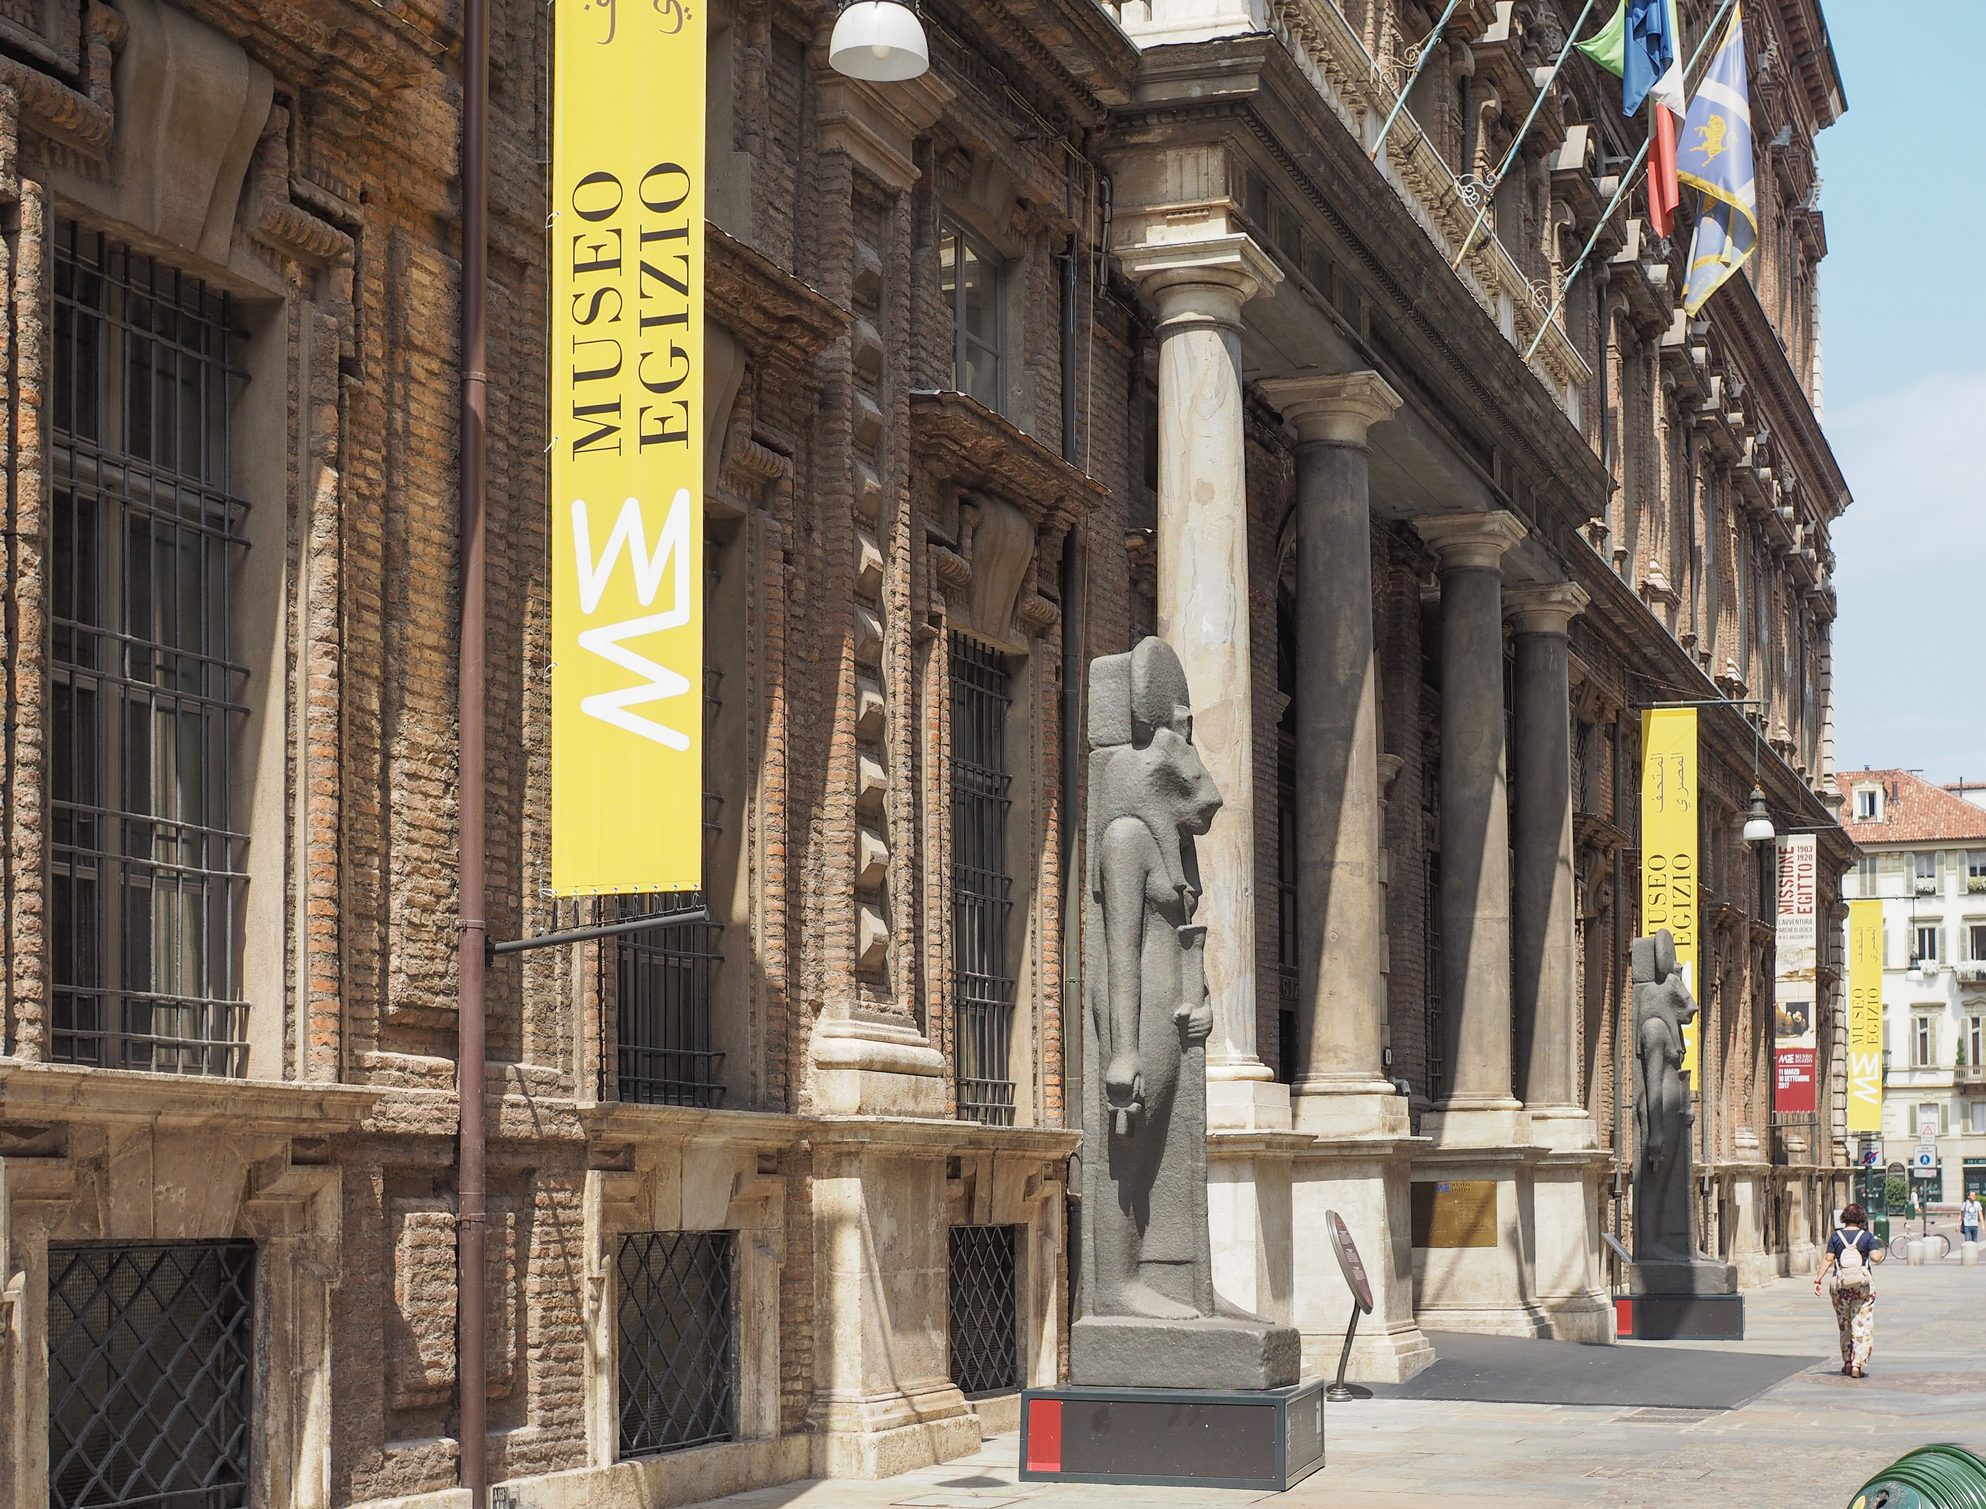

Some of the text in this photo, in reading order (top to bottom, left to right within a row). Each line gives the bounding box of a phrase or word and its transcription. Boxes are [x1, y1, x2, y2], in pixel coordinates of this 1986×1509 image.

[572, 170, 624, 462] MUSEO
[638, 162, 691, 454] EGIZIO
[1778, 846, 1794, 915] MISSIONE
[1797, 845, 1813, 853] 1903
[1648, 853, 1668, 938] USEO
[1671, 853, 1692, 948] EGIZIO
[1797, 863, 1813, 915] EGITTO
[1852, 988, 1865, 1045] MUSEO
[1867, 987, 1880, 1045] EGIZIO
